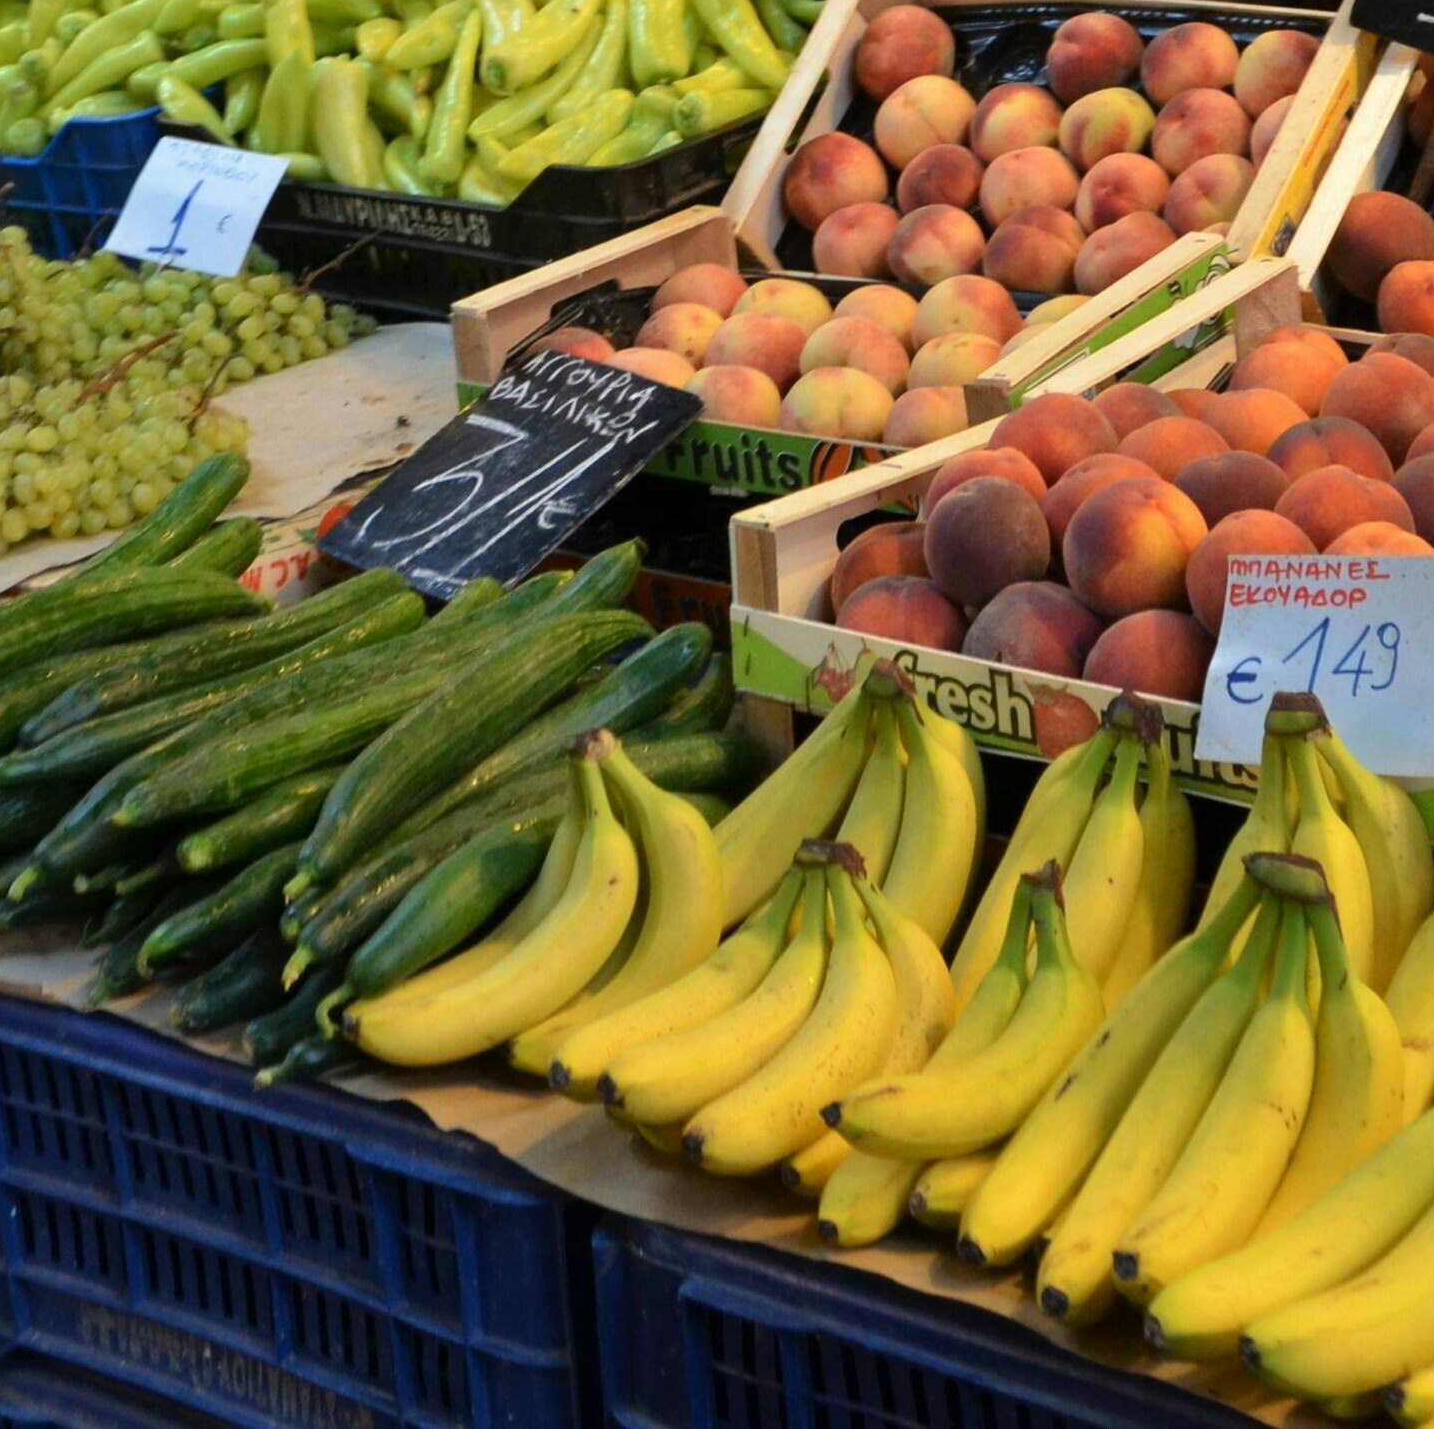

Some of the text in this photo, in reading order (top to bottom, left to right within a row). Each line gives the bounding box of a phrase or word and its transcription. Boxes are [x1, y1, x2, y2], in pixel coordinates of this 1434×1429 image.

[666, 432, 804, 492] Fruits
[1229, 558, 1391, 582] ΜΠΑΝΑΝΕΣ
[649, 579, 729, 626] Fru
[1228, 583, 1368, 610] ΕΚΟΥΑΔΟΡ
[892, 649, 1037, 746] fresh
